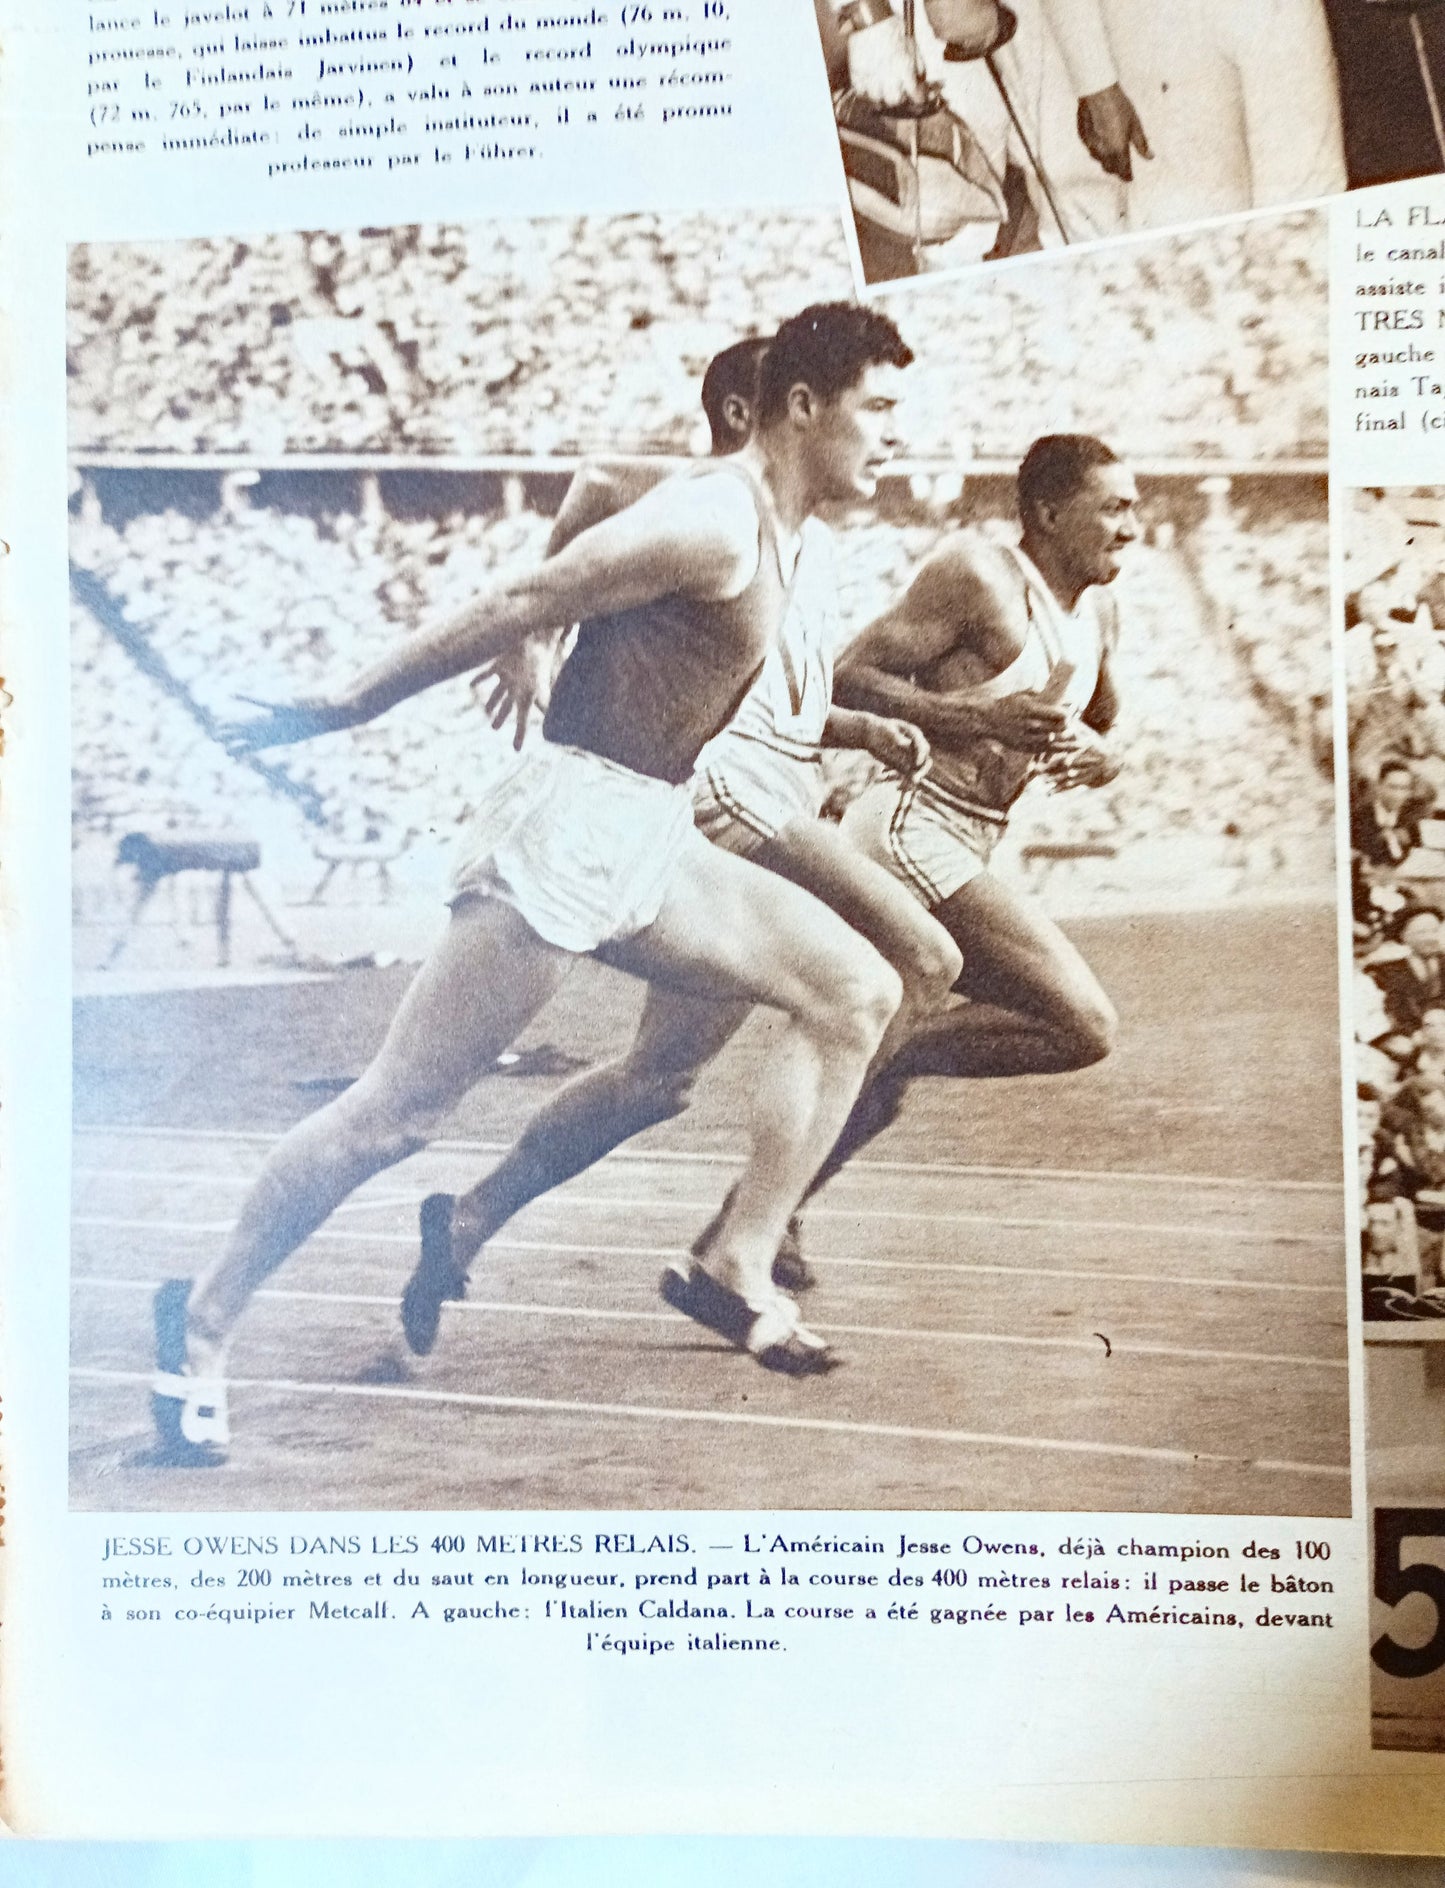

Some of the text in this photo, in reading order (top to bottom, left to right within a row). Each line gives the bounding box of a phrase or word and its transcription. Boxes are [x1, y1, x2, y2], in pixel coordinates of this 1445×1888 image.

[89, 14, 140, 32] lance
[154, 9, 170, 28] le
[185, 3, 248, 29] javelot
[263, 1, 273, 19] à
[193, 40, 224, 59] qui
[235, 33, 288, 53] laisse
[299, 26, 387, 48] imbattus
[397, 21, 414, 40] le
[424, 14, 489, 38] record
[500, 13, 526, 32] du
[537, 6, 608, 30] monde
[621, 4, 652, 29] (76
[663, 8, 689, 22] m.
[704, 0, 730, 21] 10,
[88, 80, 119, 97] par
[145, 70, 162, 90] le
[317, 52, 413, 82] Jarvinen)
[440, 54, 456, 68] et
[483, 46, 500, 65] le
[526, 40, 591, 62] record
[616, 34, 731, 60] olympique
[90, 104, 120, 127] (72
[132, 110, 157, 121] m.
[170, 99, 207, 119] 765,
[220, 102, 251, 119] par
[264, 94, 280, 111] le
[292, 87, 372, 110] même),
[384, 92, 395, 104] a
[408, 82, 449, 102] valu
[462, 81, 472, 98] à
[483, 84, 517, 97] son
[529, 77, 597, 94] auteur
[609, 77, 647, 90] une
[88, 142, 145, 157] pense
[298, 120, 321, 141] de
[339, 116, 407, 140] simple
[558, 106, 569, 125] il
[587, 111, 597, 123] a
[615, 102, 645, 121] été
[663, 104, 732, 124] promu
[269, 154, 373, 178] professeur
[388, 154, 419, 171] par
[435, 146, 451, 164] le
[1357, 208, 1393, 228] LA
[1357, 243, 1375, 262] le
[1355, 277, 1426, 296] assiste
[1354, 309, 1424, 331] TRES
[1355, 342, 1436, 369] gauche
[1355, 375, 1445, 399] nais Ta
[1355, 410, 1406, 432] final
[102, 1537, 172, 1561] JESSE
[184, 1536, 278, 1555] OWENS
[291, 1536, 361, 1554] DANS
[372, 1535, 419, 1554] LES
[430, 1535, 465, 1554] 400
[477, 1534, 583, 1553] METRES
[595, 1534, 696, 1554] RELAIS.
[744, 1533, 884, 1554] L'Américain
[896, 1534, 951, 1558] Jesse
[962, 1535, 1045, 1558] Owens,
[1058, 1536, 1106, 1560] déjà
[1117, 1537, 1230, 1562] champion
[1241, 1540, 1281, 1560] des
[1295, 1540, 1332, 1561] 100
[103, 1571, 177, 1590] mètres,
[191, 1569, 225, 1588] des
[237, 1569, 272, 1587] 200
[283, 1569, 352, 1587] mètres
[364, 1572, 382, 1586] et
[393, 1568, 420, 1586] du
[432, 1572, 474, 1587] saut
[484, 1574, 509, 1586] en
[522, 1567, 625, 1589] longueur,
[635, 1566, 697, 1590] prend
[707, 1571, 750, 1590] part
[759, 1567, 771, 1586] à
[781, 1566, 800, 1586] la
[809, 1574, 878, 1586] course
[888, 1567, 924, 1587] des
[931, 1568, 967, 1587] 400
[978, 1570, 1051, 1589] mètres
[1144, 1571, 1158, 1590] il
[1169, 1579, 1229, 1595] passe
[1240, 1573, 1260, 1593] le
[1270, 1573, 1335, 1594] bâton
[101, 1603, 112, 1620] à
[126, 1610, 161, 1621] son
[175, 1602, 295, 1624] co-équipier
[310, 1600, 395, 1619] Metcalf.
[411, 1601, 430, 1619] A
[546, 1599, 628, 1619] l'Italien
[639, 1598, 735, 1619] Caldana.
[746, 1599, 775, 1619] La
[784, 1607, 854, 1619] course
[865, 1608, 876, 1619] a
[887, 1601, 919, 1621] été
[930, 1602, 1007, 1625] gagnée
[1019, 1610, 1055, 1626] par
[1065, 1603, 1095, 1623] les
[1106, 1603, 1244, 1629] Américains,
[1255, 1606, 1334, 1629] devant
[587, 1632, 787, 1655] l'équipe italienne.
